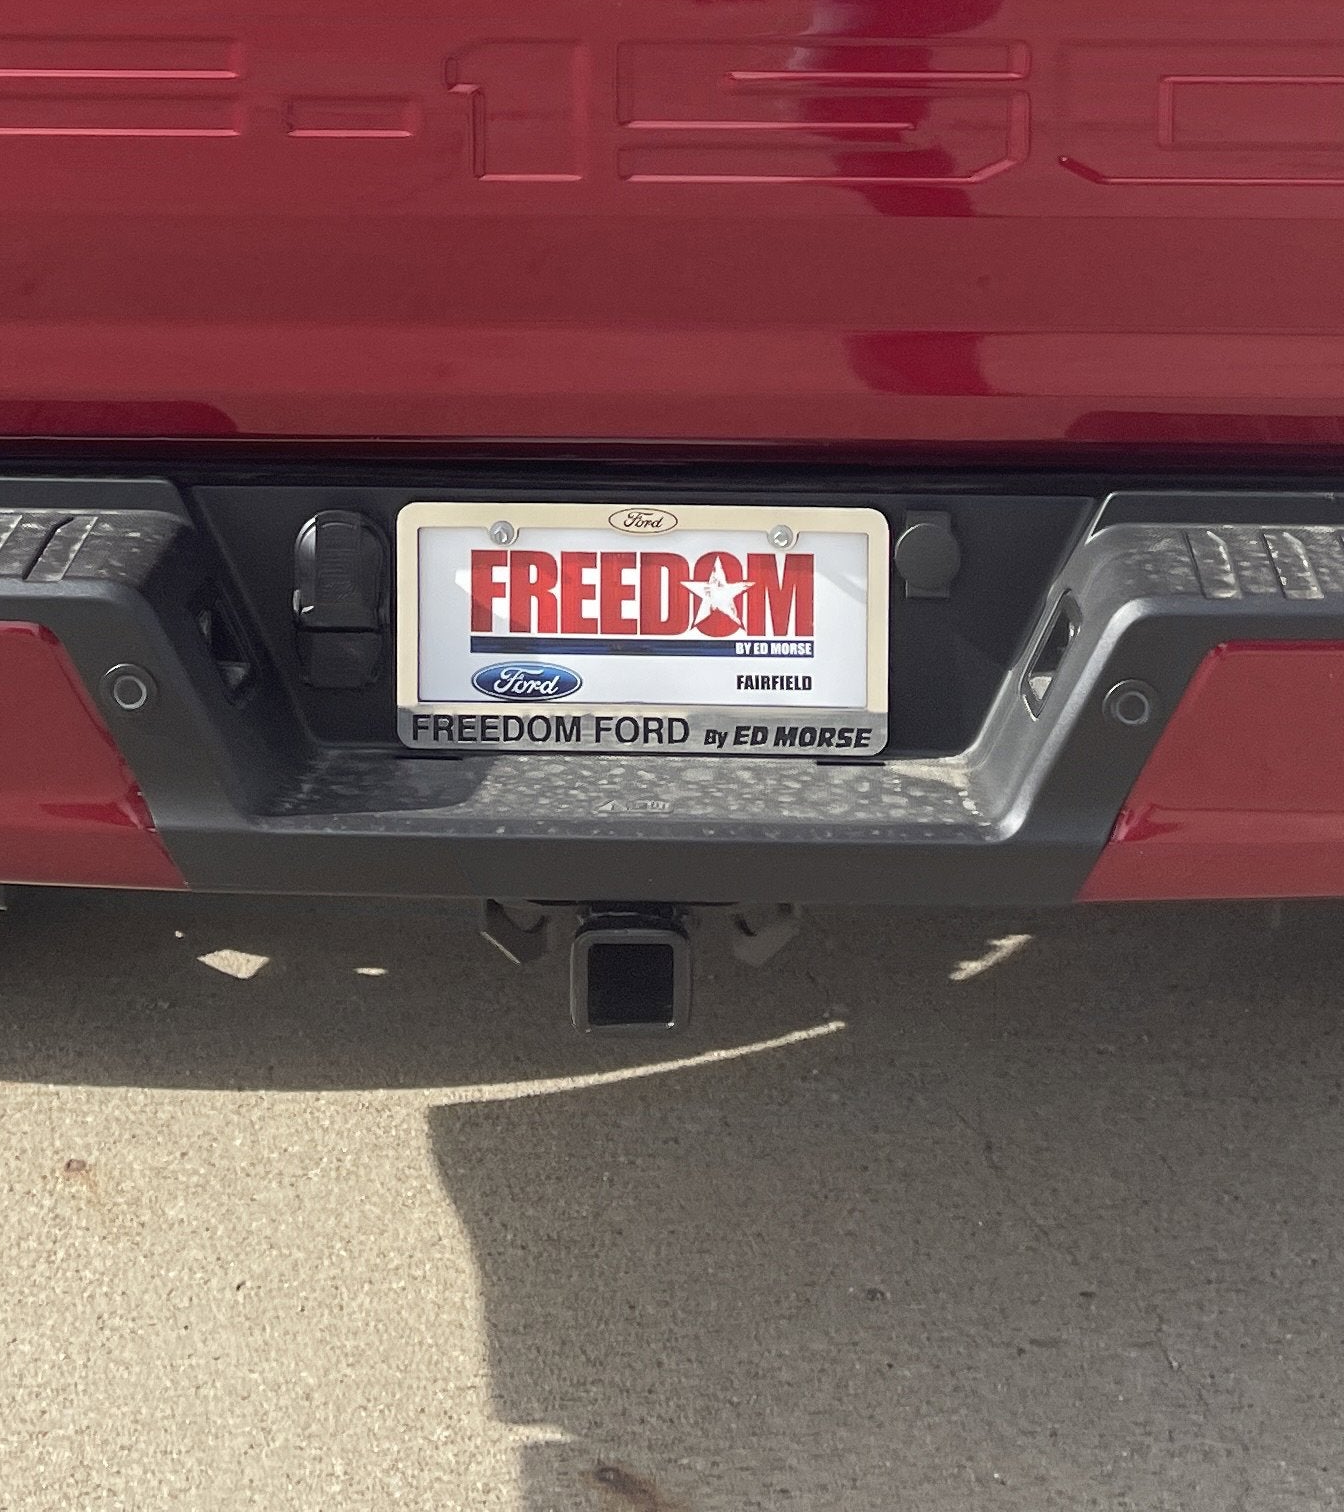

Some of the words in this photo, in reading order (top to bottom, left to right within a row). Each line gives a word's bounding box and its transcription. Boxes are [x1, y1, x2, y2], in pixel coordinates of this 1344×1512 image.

[622, 512, 664, 530] Ford
[470, 550, 814, 636] FREEDOM
[735, 642, 751, 656] BY
[753, 642, 769, 656] ED
[770, 642, 812, 656] MORSE
[492, 666, 562, 698] Ford
[736, 673, 812, 691] FAIRFIELD
[412, 715, 582, 743] FREEDOM
[595, 716, 690, 744] FORD
[704, 729, 728, 748] By
[734, 727, 768, 748] ED
[775, 728, 873, 748] MORSE
